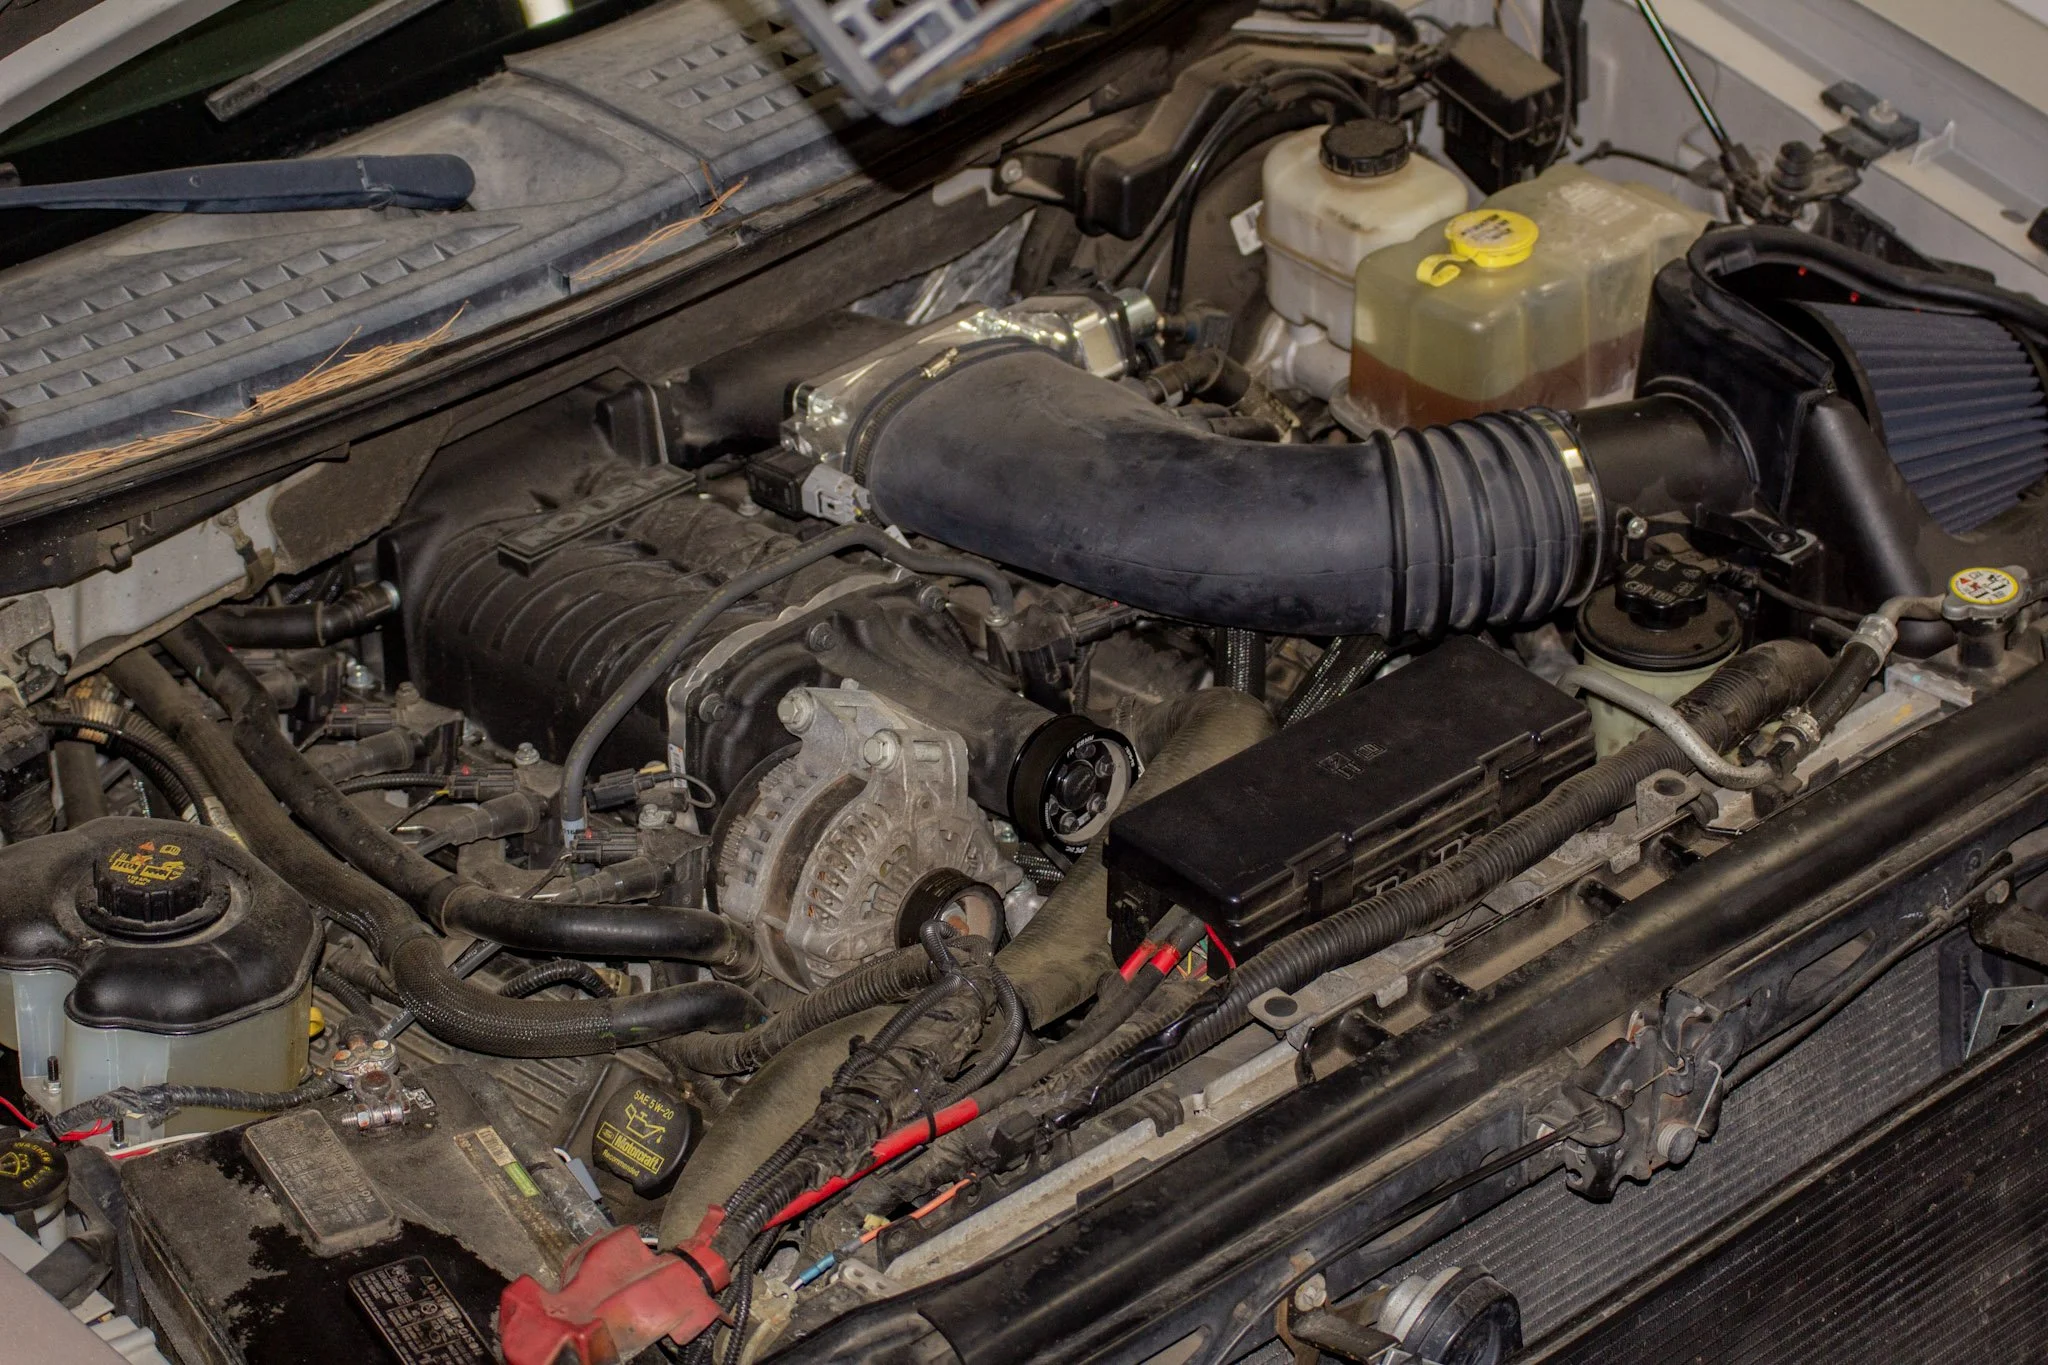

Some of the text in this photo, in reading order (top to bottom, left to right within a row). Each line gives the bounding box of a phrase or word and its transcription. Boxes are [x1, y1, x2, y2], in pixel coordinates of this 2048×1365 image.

[633, 1089, 650, 1105] SAE
[602, 1149, 640, 1177] Recommended
[613, 1135, 660, 1171] Motorcraft
